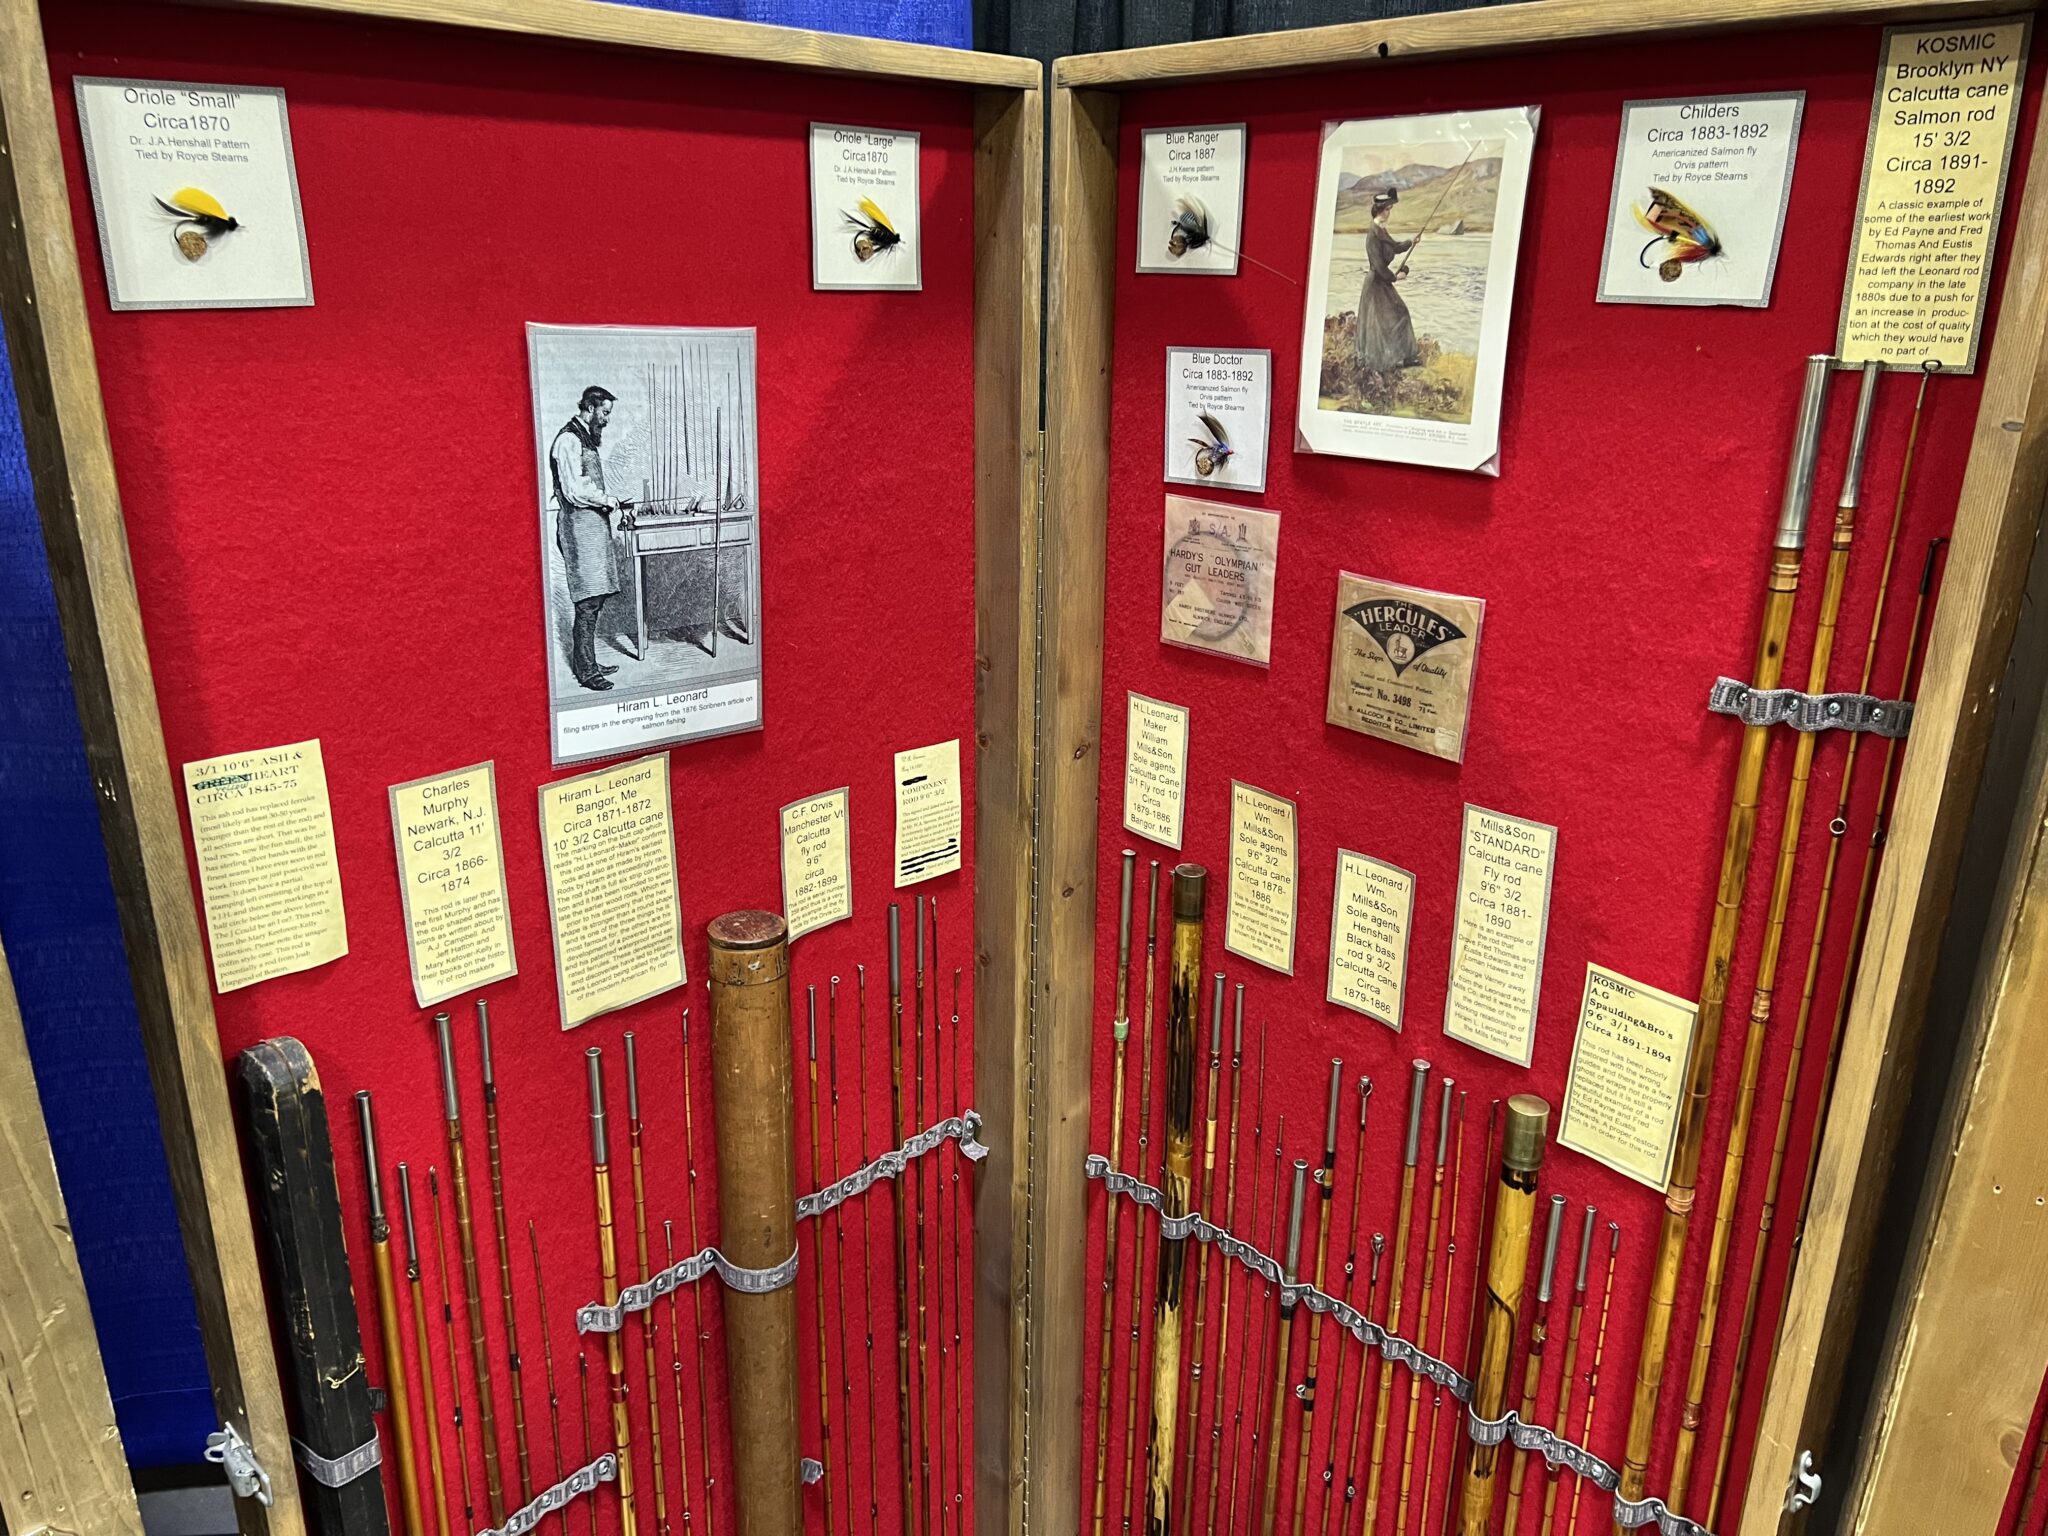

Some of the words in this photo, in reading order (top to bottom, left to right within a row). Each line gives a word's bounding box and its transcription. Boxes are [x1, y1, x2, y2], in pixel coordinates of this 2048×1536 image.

[1917, 33, 1996, 54] KOSMIC
[1897, 61, 1973, 79] Brooklyn
[1981, 56, 2009, 73] NY
[124, 88, 175, 106] Oriole
[1888, 86, 1959, 102] Calcutta
[1966, 83, 2009, 98] cane
[1680, 104, 1740, 119] Childers
[1894, 110, 1960, 125] Salmon
[1967, 105, 1995, 121] rod
[144, 113, 229, 131] Circa1870
[834, 131, 861, 144] Oriole
[1166, 134, 1185, 144] Blue
[1188, 132, 1219, 145] Ranger
[1647, 129, 1683, 142] Circa
[1690, 124, 1769, 140] 1883-1892
[1914, 133, 1938, 148] 15'
[1944, 131, 1970, 147] 3/2
[130, 136, 144, 145] Dr.
[215, 139, 250, 149] Pattern
[135, 150, 158, 159] Tied
[162, 150, 173, 161] by
[177, 151, 208, 162] Royce
[212, 153, 248, 162] Stearns
[1169, 150, 1190, 160] Circa
[1195, 148, 1215, 159] 1887
[1652, 149, 1708, 158] Americanized
[1711, 147, 1744, 156] Salmon
[1747, 146, 1757, 156] fly
[1674, 161, 1696, 169] Orvis
[1698, 160, 1728, 169] pattern
[1886, 157, 1932, 172] Circa
[1940, 154, 1988, 170] 1891-
[1654, 174, 1670, 182] Tied
[1672, 173, 1682, 183] by
[1685, 173, 1711, 182] Royce
[1714, 172, 1748, 181] Stearns
[1914, 179, 1955, 193] 1892
[1878, 201, 1886, 210] A
[1889, 200, 1924, 209] classic
[1927, 200, 1970, 209] example
[1973, 198, 1983, 207] of
[1864, 215, 1892, 223] some
[1896, 214, 1907, 222] of
[1909, 214, 1925, 222] the
[1928, 213, 1965, 221] earliest
[1968, 212, 1991, 220] work
[1869, 228, 1881, 237] by
[1885, 227, 1898, 236] Ed
[1902, 227, 1934, 237] Payne
[1938, 226, 1956, 235] and
[1959, 226, 1983, 235] Fred
[1875, 241, 1916, 249] Thomas
[1919, 240, 1939, 248] And
[1943, 240, 1973, 248] Eustis
[1861, 254, 1905, 262] Edwards
[1909, 254, 1931, 264] right
[1935, 253, 1957, 261] after
[1961, 253, 1981, 263] they
[1192, 353, 1210, 363] Blue
[1214, 354, 1243, 365] Doctor
[1183, 369, 1203, 379] Circa
[1207, 370, 1253, 381] 1883-1892
[1185, 563, 1201, 573] GUT
[1208, 567, 1245, 581] LEADERS
[1380, 623, 1425, 639] LEADER
[617, 700, 649, 713] Hiram
[654, 698, 662, 707] L.
[666, 689, 708, 706] Leonard
[1377, 689, 1390, 702] No.
[1393, 694, 1411, 707] 3498
[582, 723, 599, 732] strips
[622, 713, 653, 725] engraving
[655, 711, 669, 719] from
[642, 722, 664, 730] salmon
[666, 717, 686, 726] fishing
[1144, 719, 1167, 732] Maker
[1142, 731, 1168, 746] William
[1137, 741, 1173, 760] Mills&Son
[1133, 753, 1148, 765] Sole
[1150, 760, 1176, 774] agents
[1129, 764, 1157, 781] Calcutta
[1159, 775, 1180, 788] Cane
[197, 790, 243, 805] CIRCA
[249, 779, 297, 795] 1845-75
[423, 780, 470, 799] Charles
[559, 789, 591, 804] Hiram
[595, 784, 605, 793] L.
[609, 769, 651, 790] Leonard
[902, 779, 948, 796] COMPONENT
[423, 797, 469, 816] Murphy
[576, 796, 617, 814] Bangor,
[621, 790, 637, 801] Me
[1142, 794, 1160, 807] Circa
[464, 807, 486, 821] N.J.
[564, 819, 592, 833] Circa
[596, 799, 651, 823] 1871-1872
[792, 809, 808, 820] C.F.
[811, 801, 833, 813] Orvis
[1133, 803, 1171, 823] 1879-1886
[554, 839, 569, 851] 10'
[573, 833, 589, 846] 3/2
[593, 820, 636, 839] Calcutta
[640, 812, 664, 825] cane
[785, 813, 831, 836] Manchester
[834, 810, 843, 819] Vt
[1243, 821, 1284, 843] Mills&Son
[1480, 818, 1535, 842] Mills&Son
[414, 831, 464, 851] Calcutta
[469, 822, 484, 835] 11'
[797, 826, 830, 845] Calcutta
[443, 846, 461, 860] 3/2
[801, 846, 810, 856] fly
[813, 840, 826, 852] rod
[1240, 833, 1257, 846] Sole
[1260, 841, 1288, 857] agents
[418, 868, 450, 883] Circa
[456, 856, 488, 872] 1866-
[1468, 845, 1511, 867] Calcutta
[1515, 862, 1543, 876] cane
[805, 868, 824, 881] circa
[1235, 857, 1267, 876] Calcutta
[1271, 870, 1291, 884] cane
[1484, 866, 1499, 881] Fly
[1504, 874, 1521, 886] rod
[441, 876, 470, 893] 1874
[795, 875, 837, 897] 1882-1899
[1352, 893, 1398, 917] Mills&Son
[1469, 892, 1495, 909] Circa
[1501, 903, 1532, 919] 1881-
[1346, 906, 1368, 919] Sole
[1371, 914, 1400, 934] agents
[1485, 913, 1511, 930] 1890
[1353, 921, 1393, 944] Henshall
[1346, 933, 1372, 949] Black
[1375, 943, 1396, 960] bass
[1357, 978, 1381, 995] Circa
[1594, 976, 1636, 998] KOSMIC
[1344, 987, 1391, 1014] 1879-1886
[1585, 1021, 1611, 1037] Circa
[1616, 1034, 1671, 1062] 1891-1894
